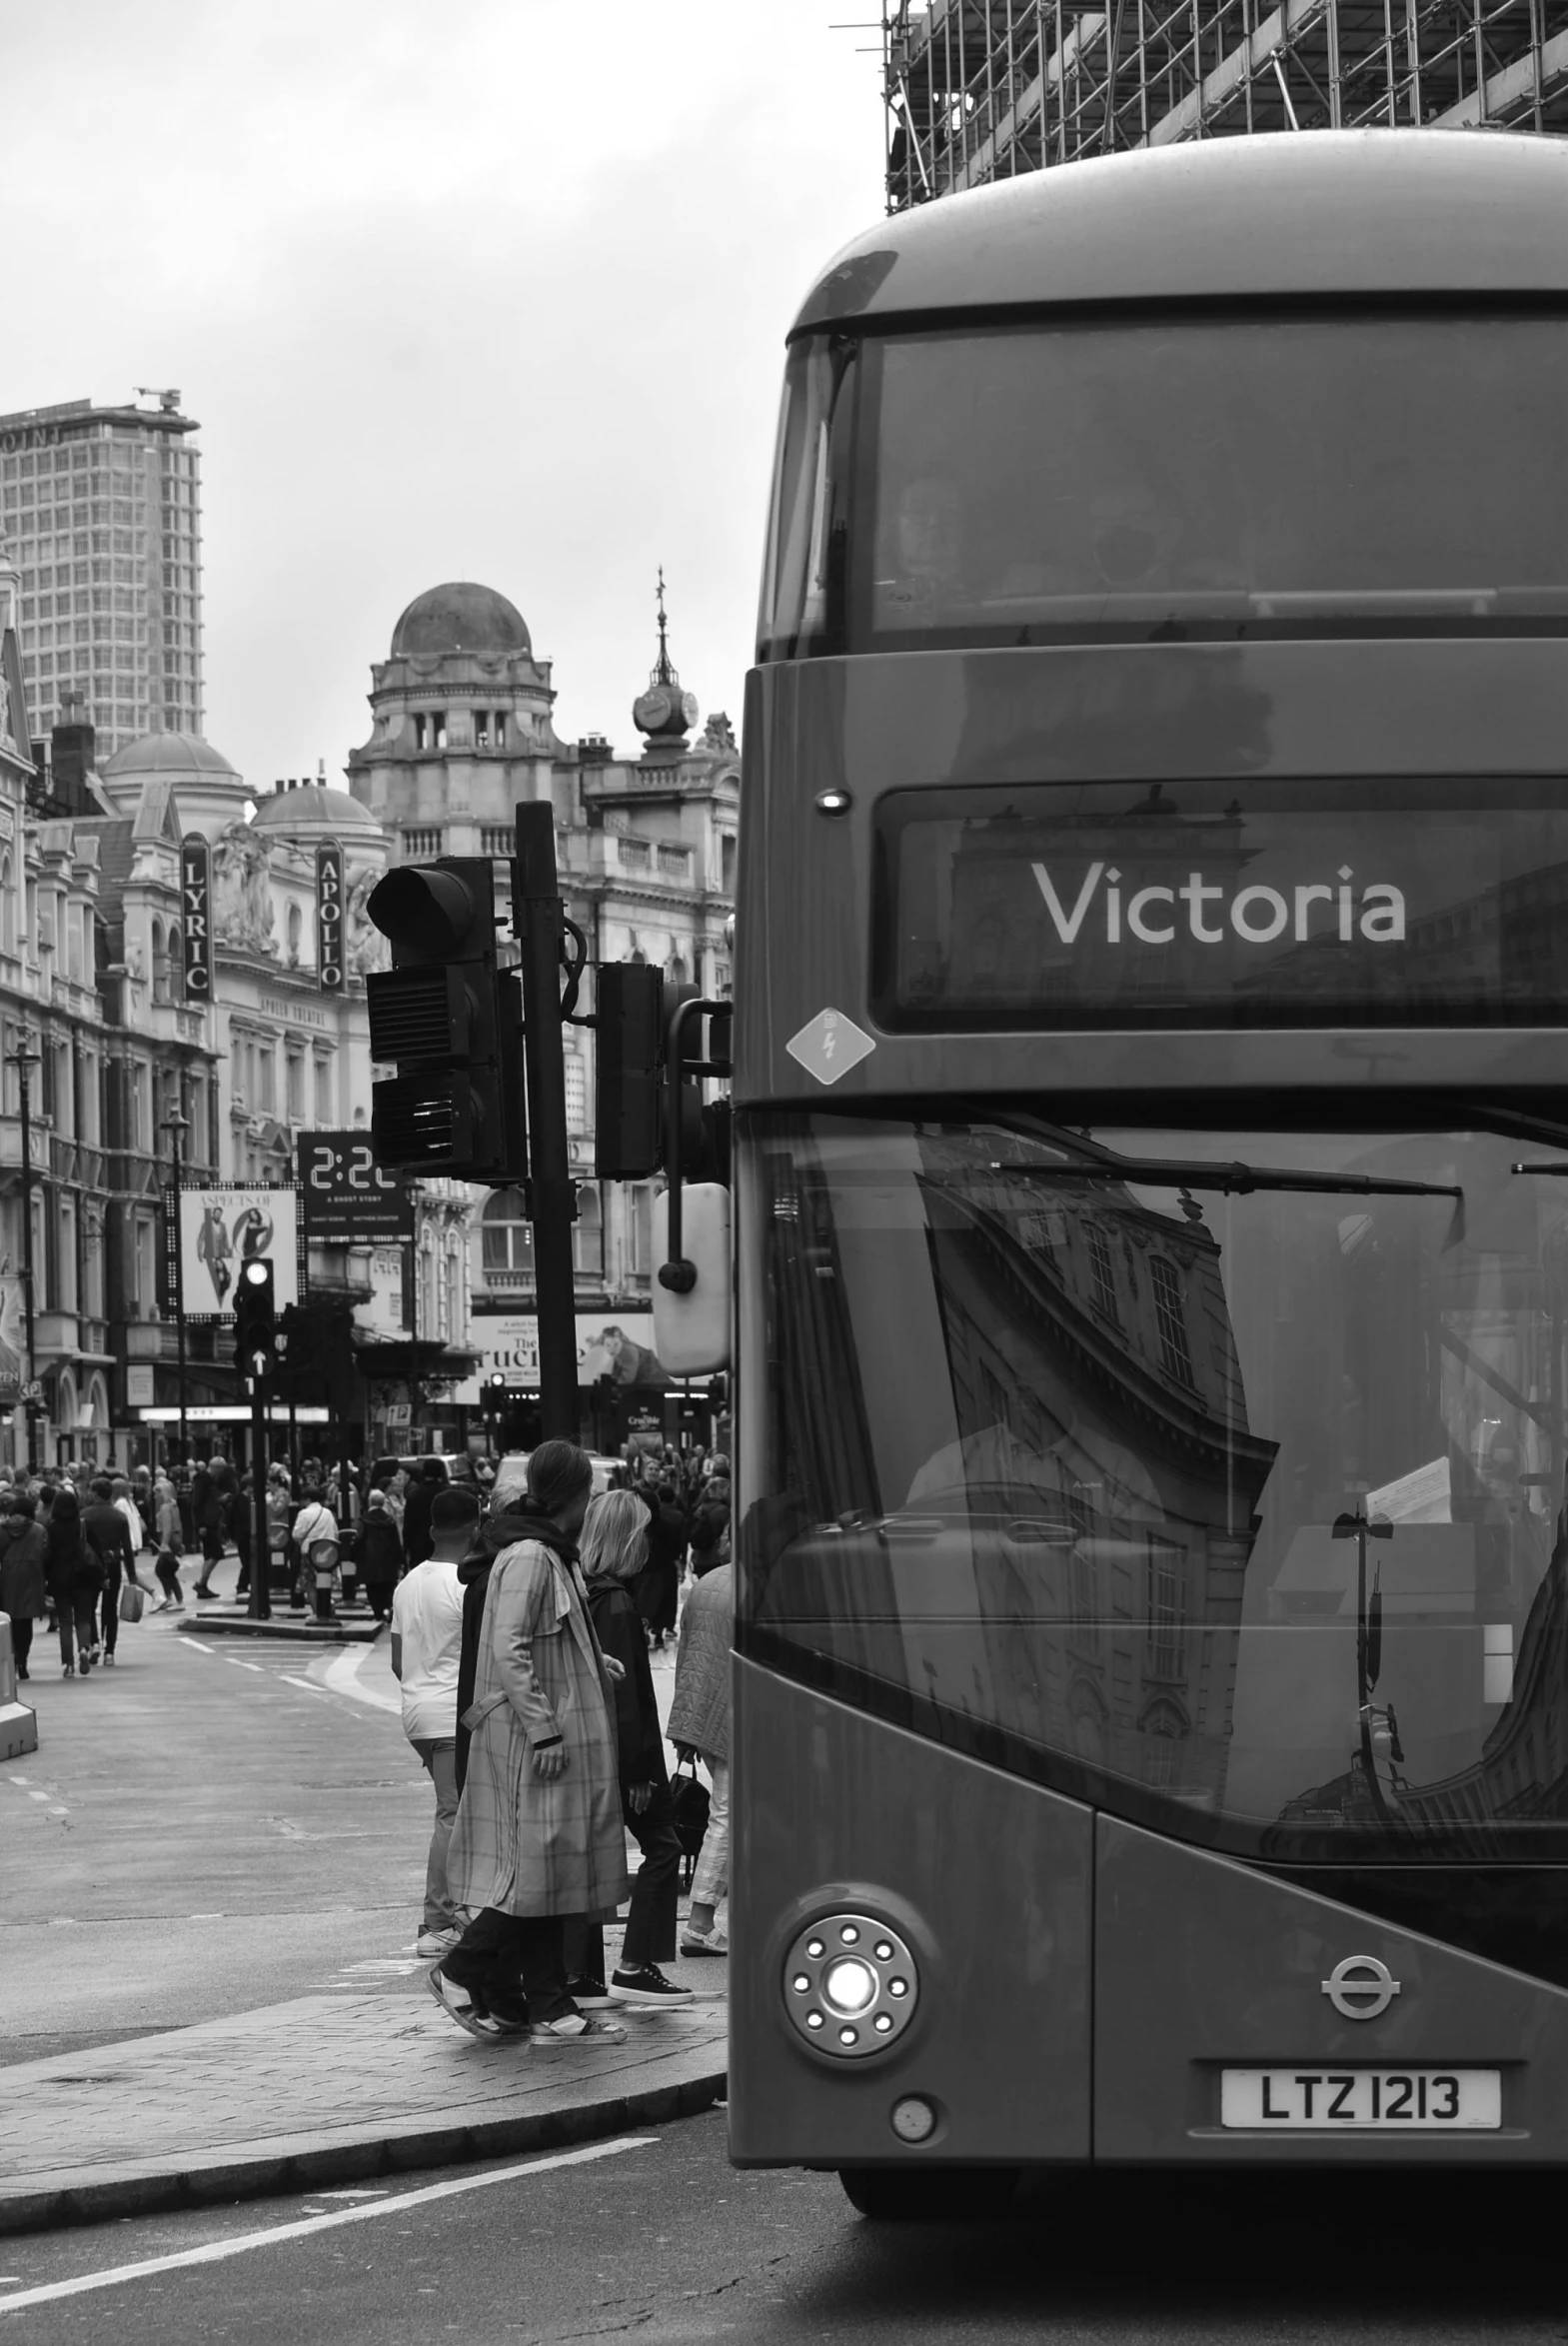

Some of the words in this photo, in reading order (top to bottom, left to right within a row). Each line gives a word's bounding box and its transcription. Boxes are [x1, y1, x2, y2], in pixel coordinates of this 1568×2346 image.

[185, 862, 209, 991] LYRIC
[320, 860, 342, 986] APOLLO
[1030, 861, 1407, 945] Victoria
[514, 1337, 538, 1348] The
[1261, 2075, 1356, 2120] LTZ
[1371, 2075, 1460, 2120] 1213
